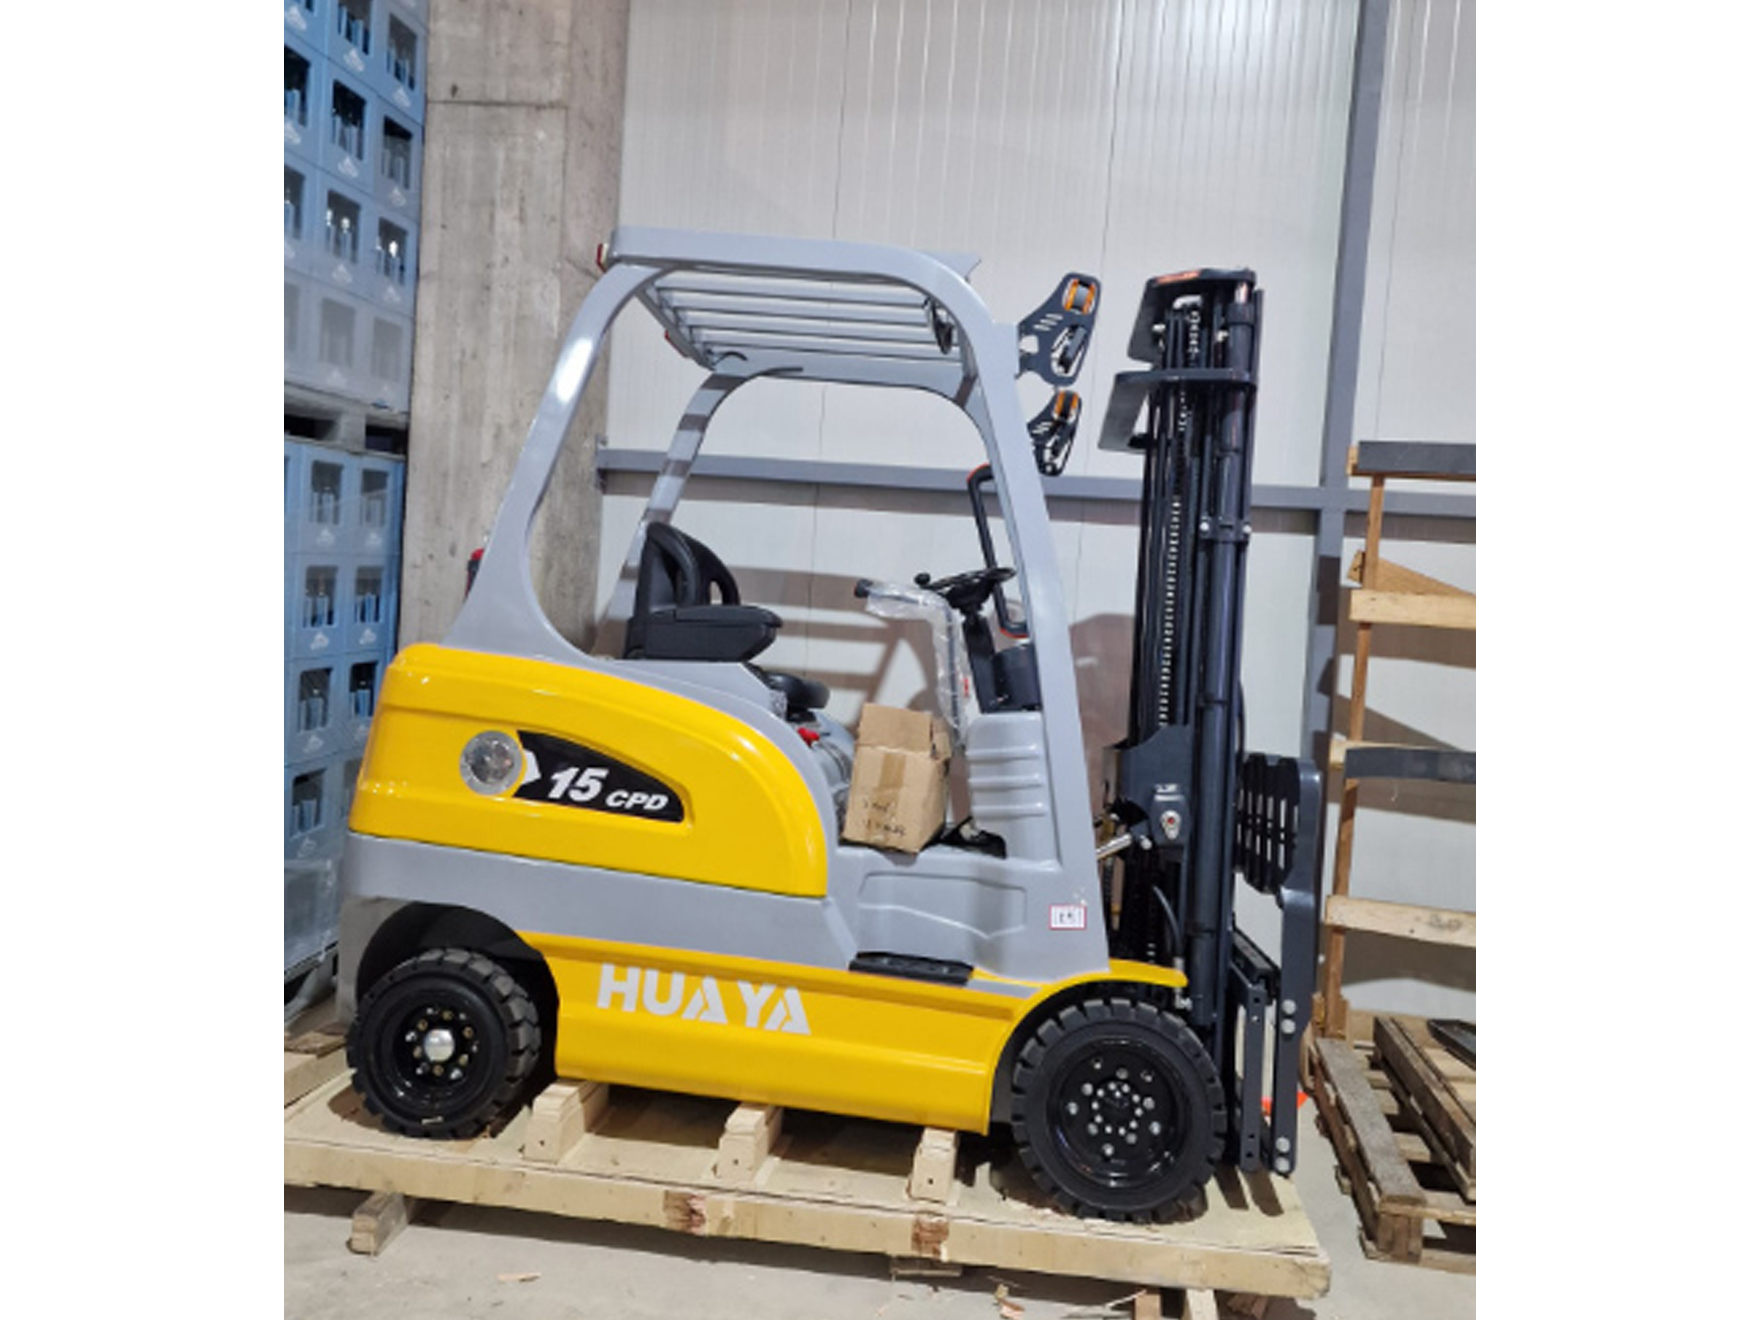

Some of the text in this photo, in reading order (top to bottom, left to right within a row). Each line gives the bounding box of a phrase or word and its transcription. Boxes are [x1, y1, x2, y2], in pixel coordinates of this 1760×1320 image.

[548, 766, 669, 810] 15 CPD
[596, 963, 812, 1036] HUAYA
